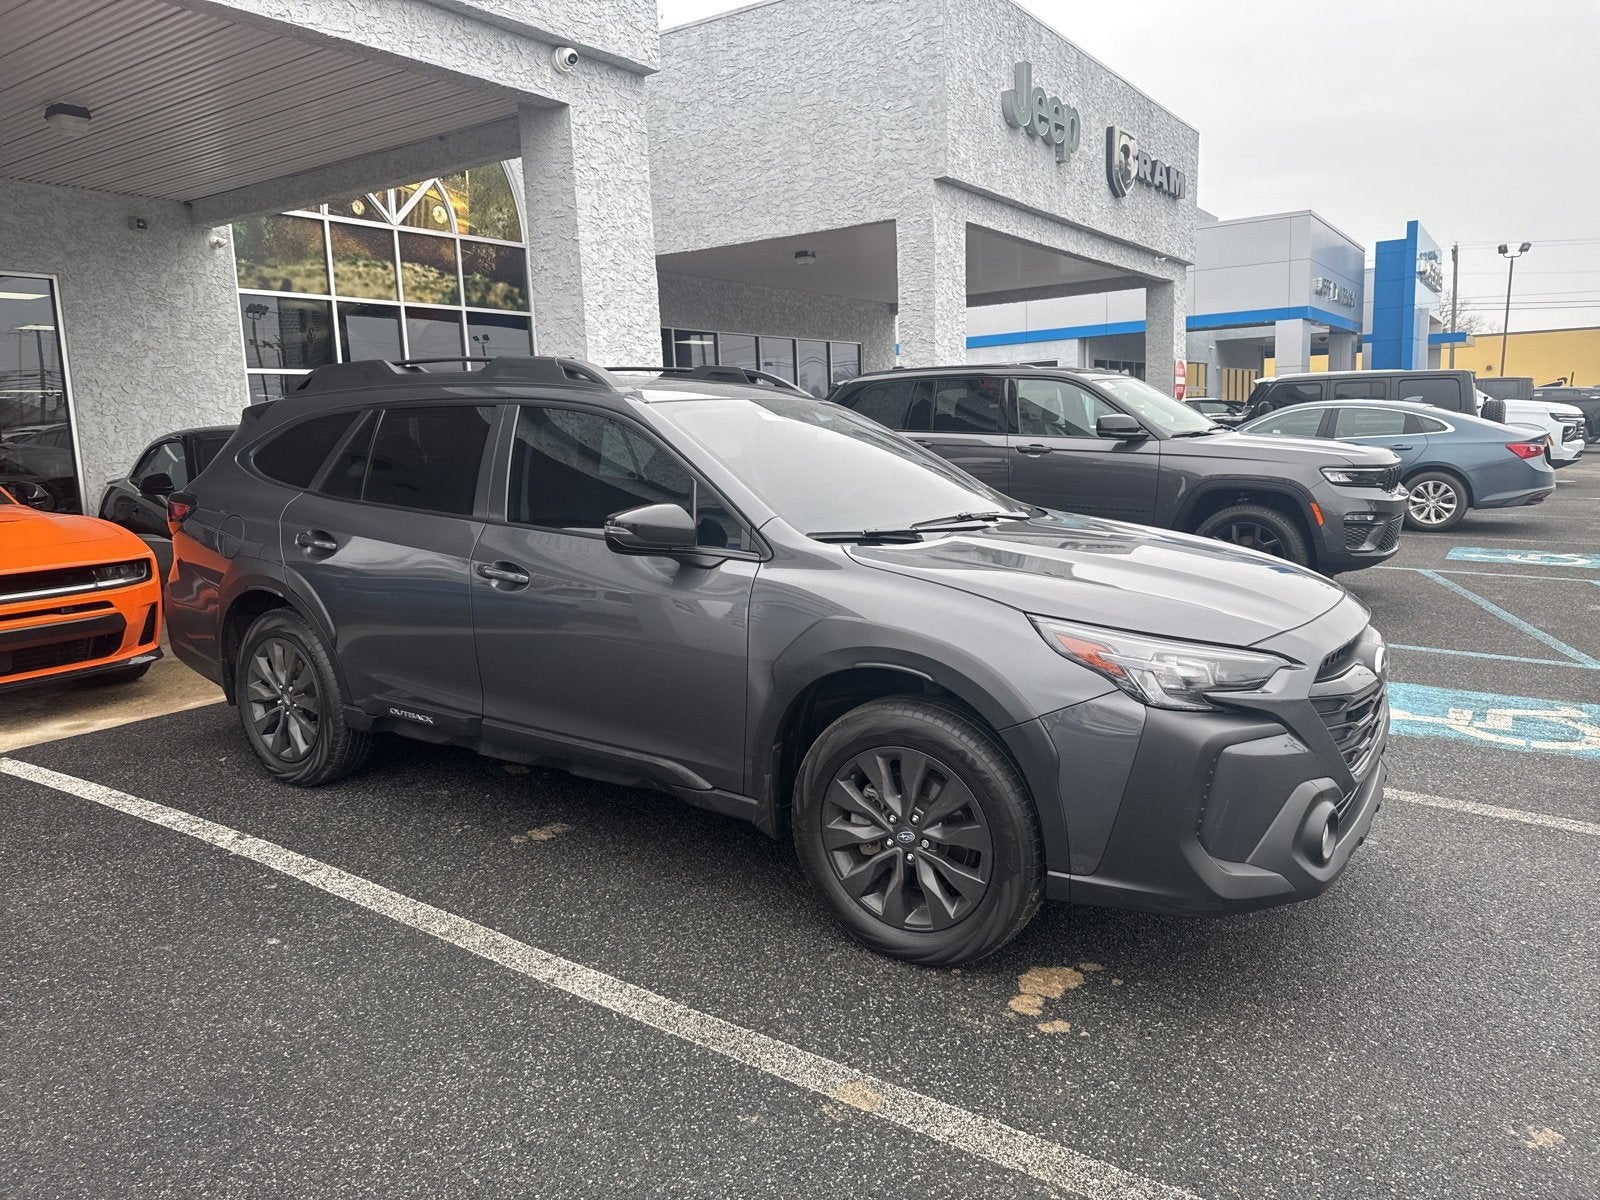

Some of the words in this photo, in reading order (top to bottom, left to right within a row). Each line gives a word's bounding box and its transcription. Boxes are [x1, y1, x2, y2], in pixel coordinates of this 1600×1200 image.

[1001, 61, 1080, 163] Jeep
[1136, 150, 1186, 199] RAM
[389, 707, 434, 724] OUTBACK
